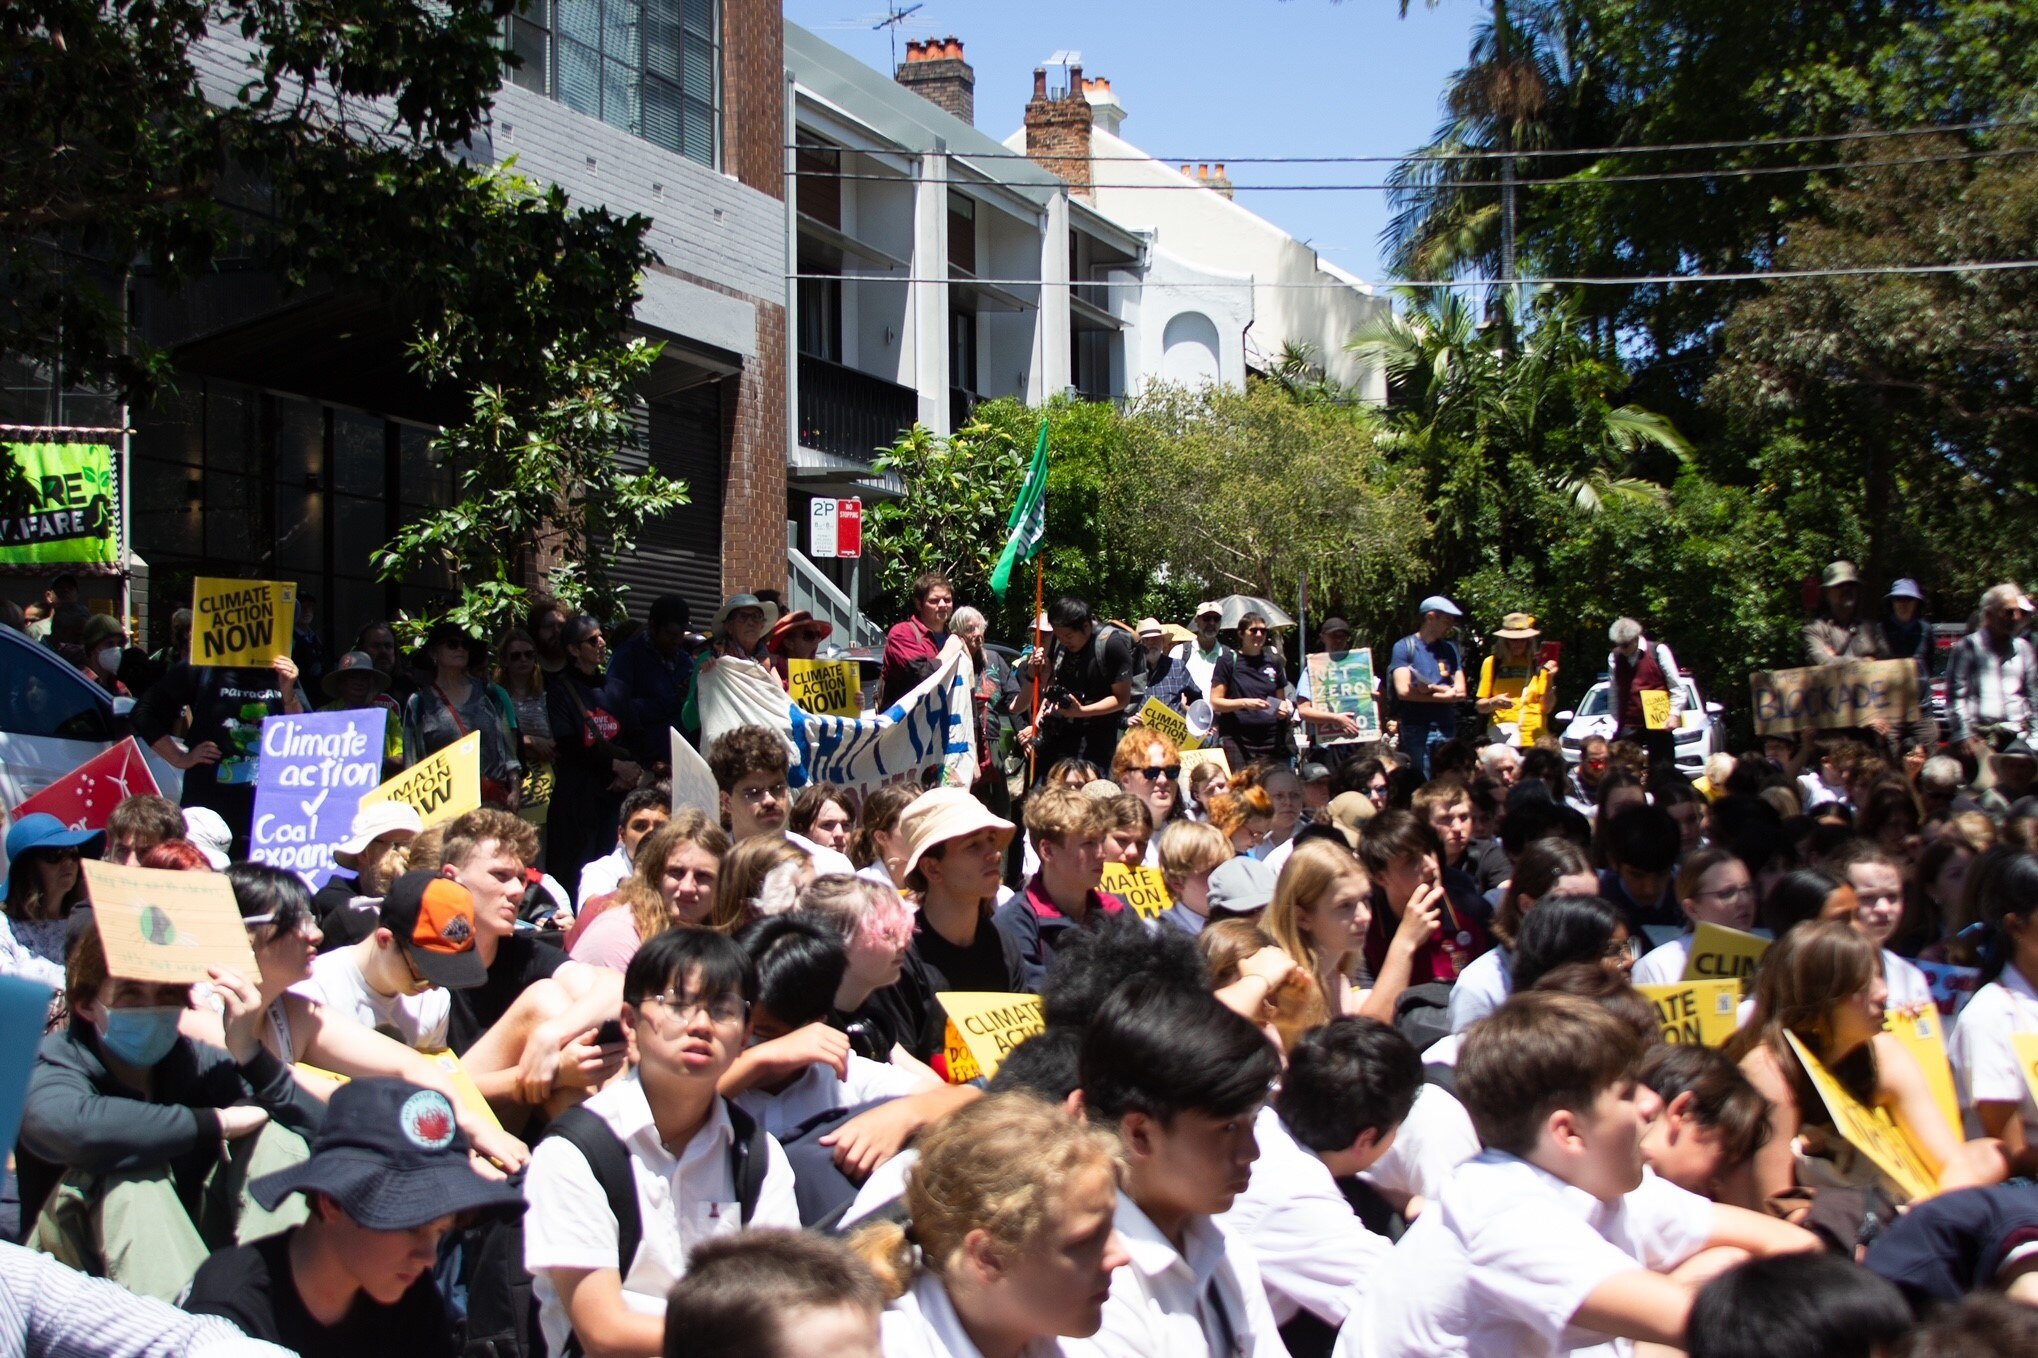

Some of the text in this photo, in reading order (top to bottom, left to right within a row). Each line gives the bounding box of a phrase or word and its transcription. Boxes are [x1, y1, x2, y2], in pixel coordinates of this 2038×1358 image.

[814, 502, 835, 516] 2P
[839, 511, 859, 519] STOPPING
[845, 503, 853, 511] NO
[200, 585, 272, 614] CLIMATE
[212, 602, 274, 629] ACTION
[203, 618, 275, 658] NOW
[792, 664, 843, 685] CLIMATE
[803, 676, 846, 696] ACTION
[1315, 666, 1350, 682] NET
[797, 688, 847, 714] NOW
[1315, 682, 1367, 699] ZERO
[1757, 680, 1892, 722] BLOCKADE
[264, 720, 369, 758] Climate
[1147, 719, 1188, 743] ACTION
[278, 757, 379, 788] action
[255, 813, 318, 844] Coal
